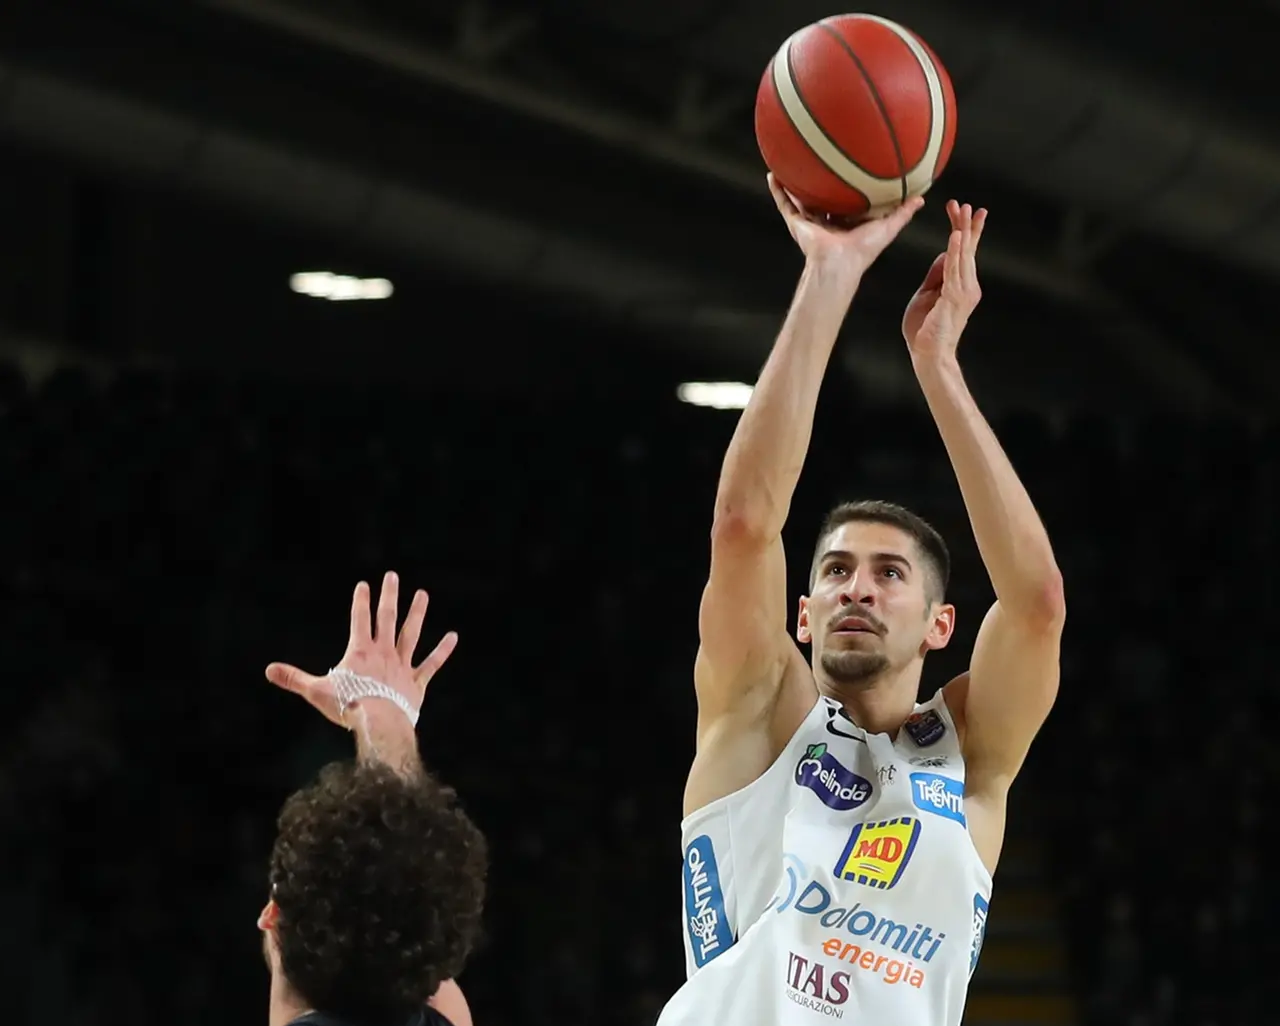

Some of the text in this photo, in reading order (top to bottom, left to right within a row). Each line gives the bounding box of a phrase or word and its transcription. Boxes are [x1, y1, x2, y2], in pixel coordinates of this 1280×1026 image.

[798, 758, 867, 802] Melinda
[854, 837, 903, 863] MD
[688, 847, 720, 960] TRENTINO
[794, 880, 946, 962] Dolomiti
[821, 938, 925, 988] energia
